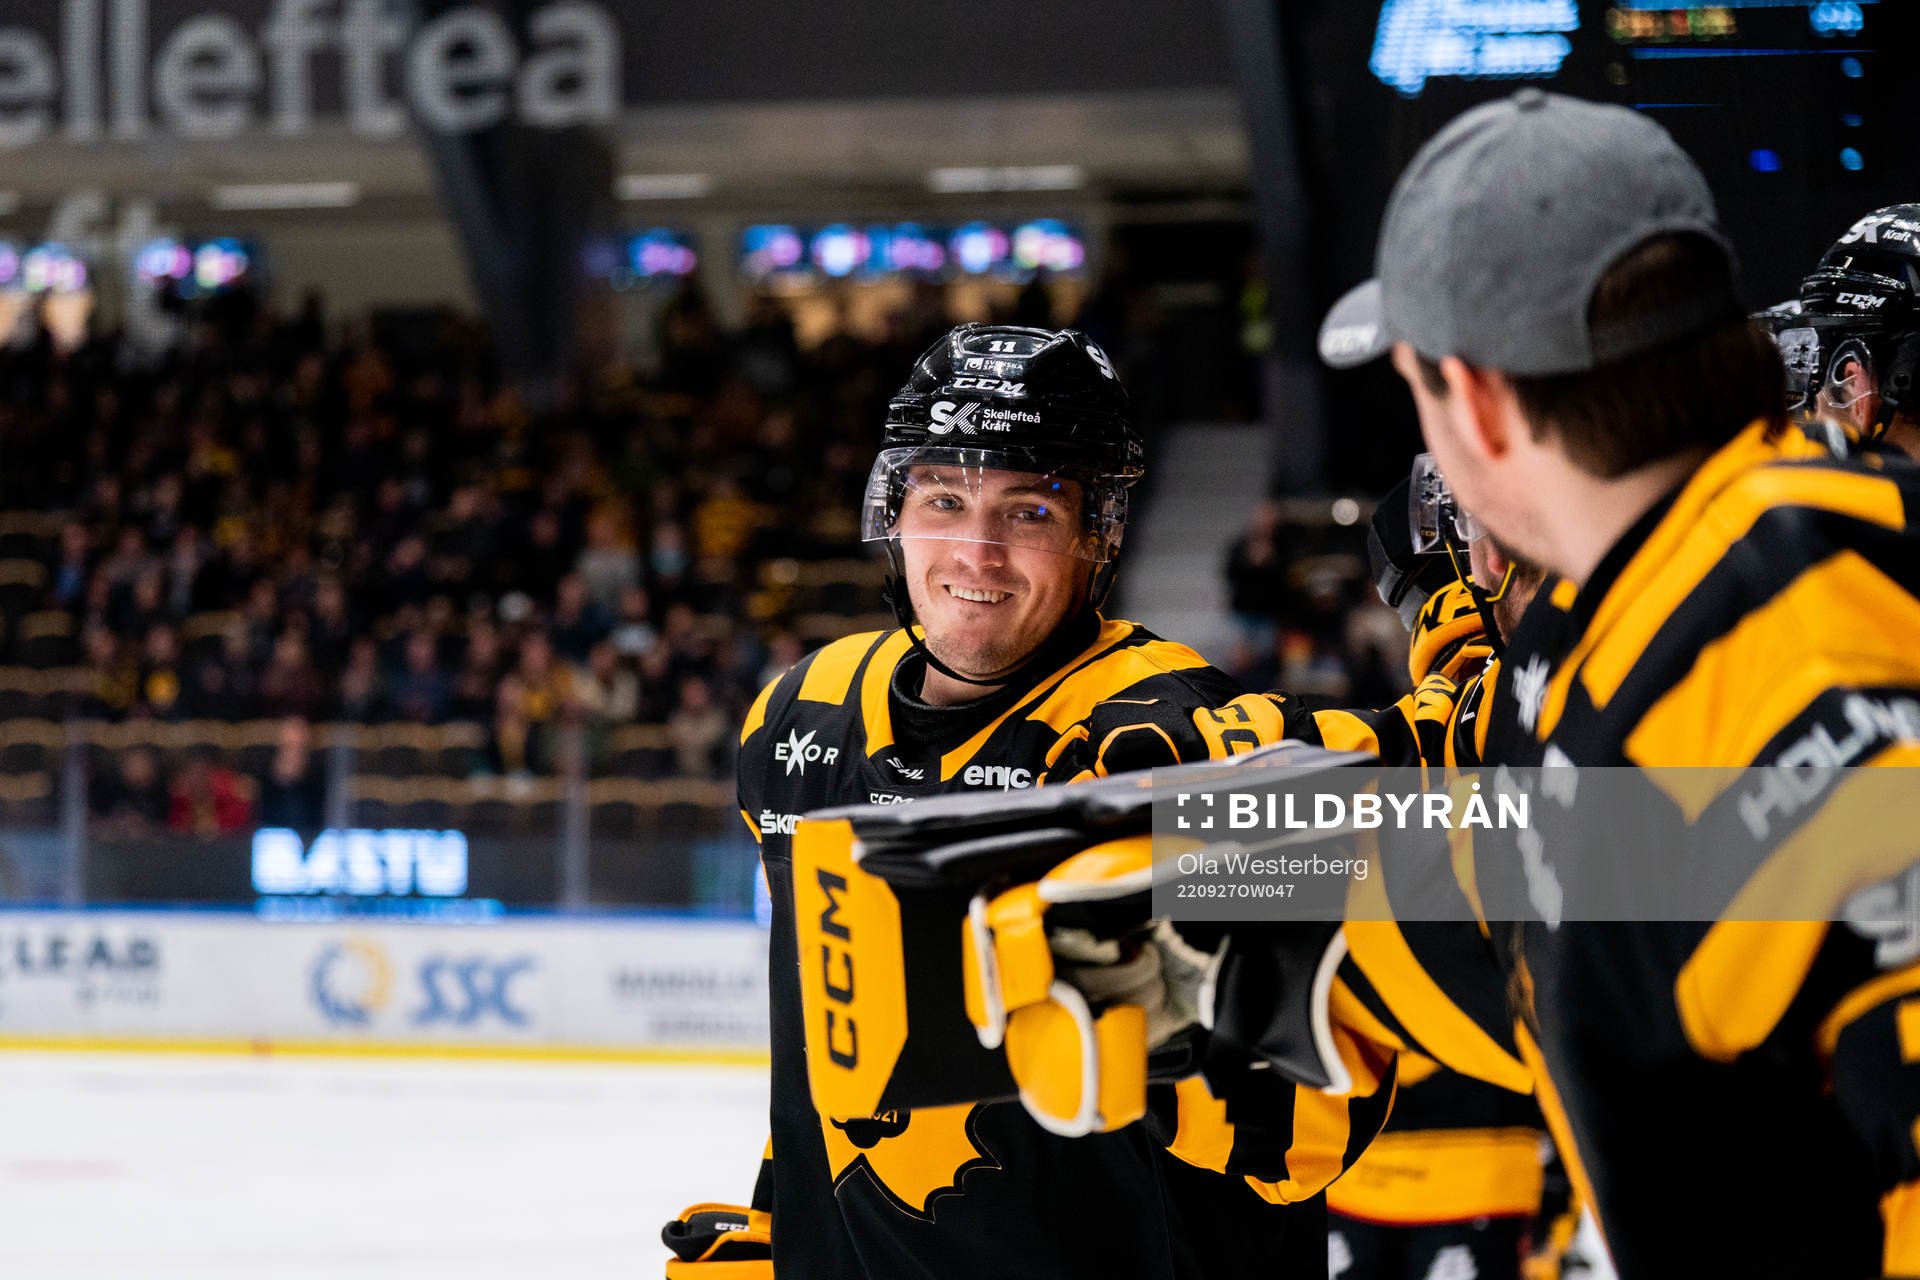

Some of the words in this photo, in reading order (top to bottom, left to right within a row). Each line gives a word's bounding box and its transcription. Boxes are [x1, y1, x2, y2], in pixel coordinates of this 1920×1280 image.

[1883, 230, 1911, 242] Kraft
[989, 341, 1016, 353] 11
[953, 377, 1026, 396] CCM
[983, 408, 1041, 424] Skellefteå
[981, 419, 1011, 432] Kraft
[775, 727, 839, 777] EXOR
[815, 866, 860, 1072] CCM
